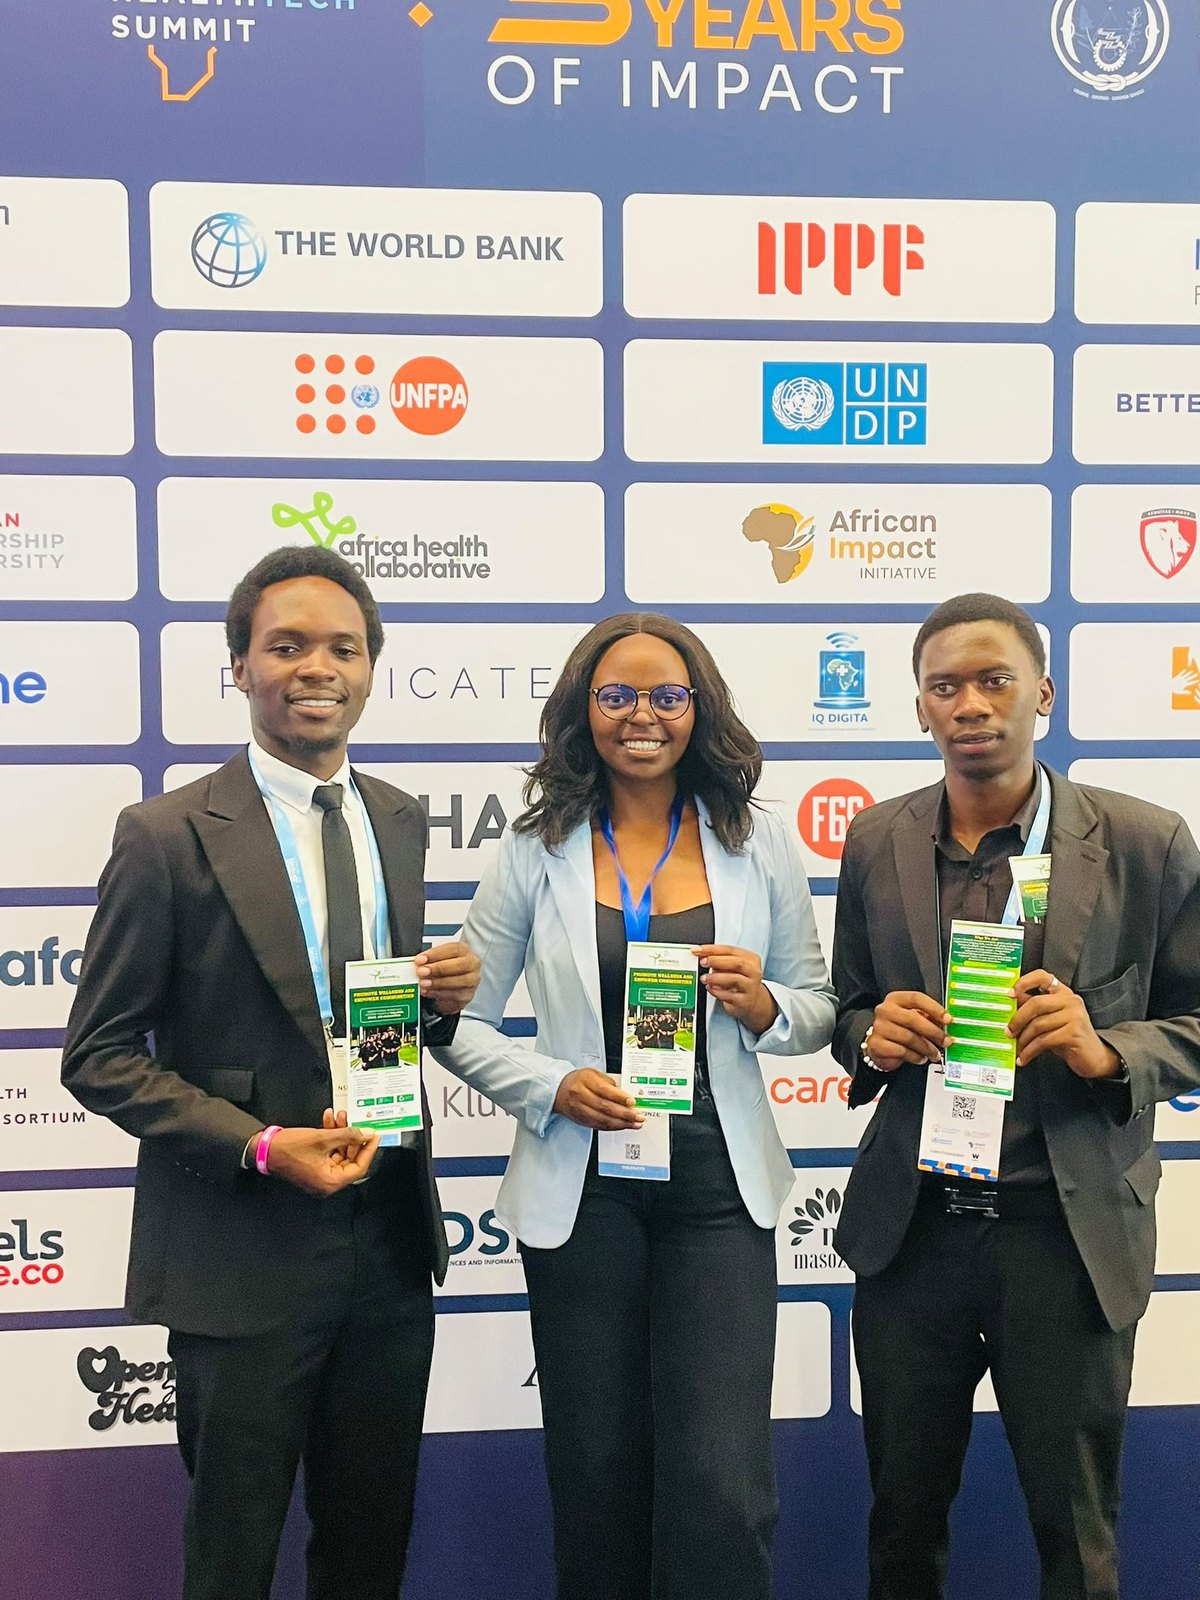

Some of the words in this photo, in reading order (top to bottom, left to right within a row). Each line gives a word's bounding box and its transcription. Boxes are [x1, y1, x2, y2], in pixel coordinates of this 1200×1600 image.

[111, 14, 256, 42] SUMMIT
[645, 0, 904, 55] YEARS
[487, 54, 581, 106] OF
[622, 59, 905, 114] IMPACT
[274, 229, 337, 257] THE
[347, 232, 465, 260] WORLD
[476, 236, 565, 262] BANK
[757, 221, 925, 297] IPPF
[390, 381, 468, 410] UNFPA
[1117, 393, 1200, 413] BETTE
[829, 508, 937, 534] African
[338, 533, 408, 557] africa
[413, 534, 488, 557] health
[829, 536, 937, 565] Impact
[351, 556, 491, 579] ollaborative
[859, 567, 937, 580] INITIATIVE
[812, 713, 825, 724] IQ
[828, 713, 868, 723] DIGITA
[443, 1085, 510, 1118] Klu
[770, 1076, 854, 1105] care
[3, 1112, 86, 1125] SORTIUM
[88, 1386, 177, 1431] Hea
